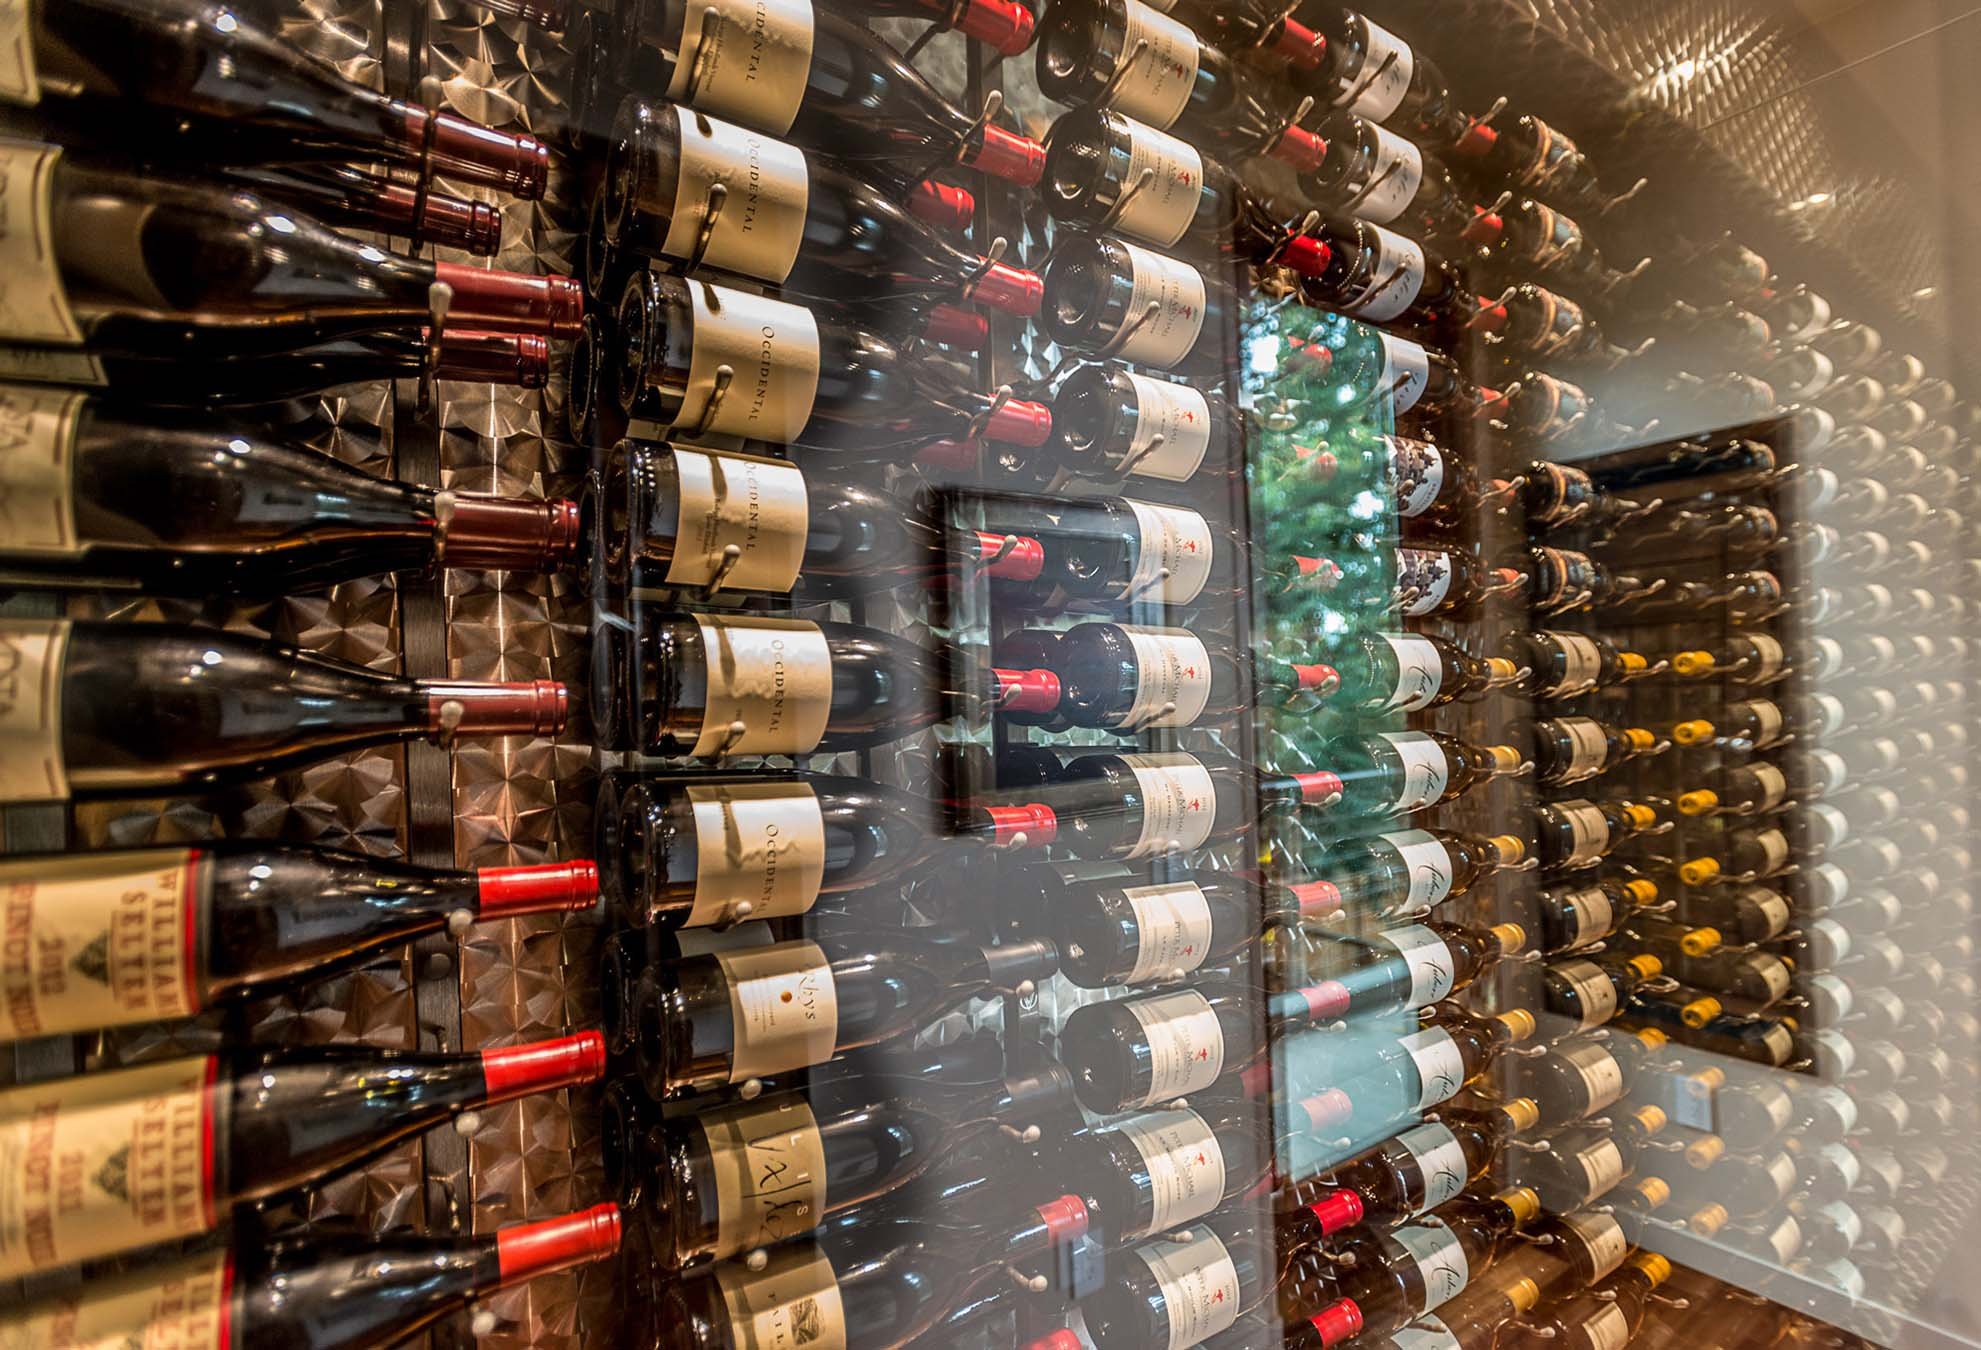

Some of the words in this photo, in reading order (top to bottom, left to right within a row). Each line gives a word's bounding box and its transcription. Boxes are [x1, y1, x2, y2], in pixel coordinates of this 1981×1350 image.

[742, 138, 761, 234] OCCIDENTAL
[749, 326, 775, 421] OCCIDENTAL
[744, 461, 760, 551] OCCIDENTAL
[768, 640, 785, 734] OCCIDENTAL
[757, 824, 779, 912] OCCIDENTAL
[119, 891, 149, 1010] SELYEM
